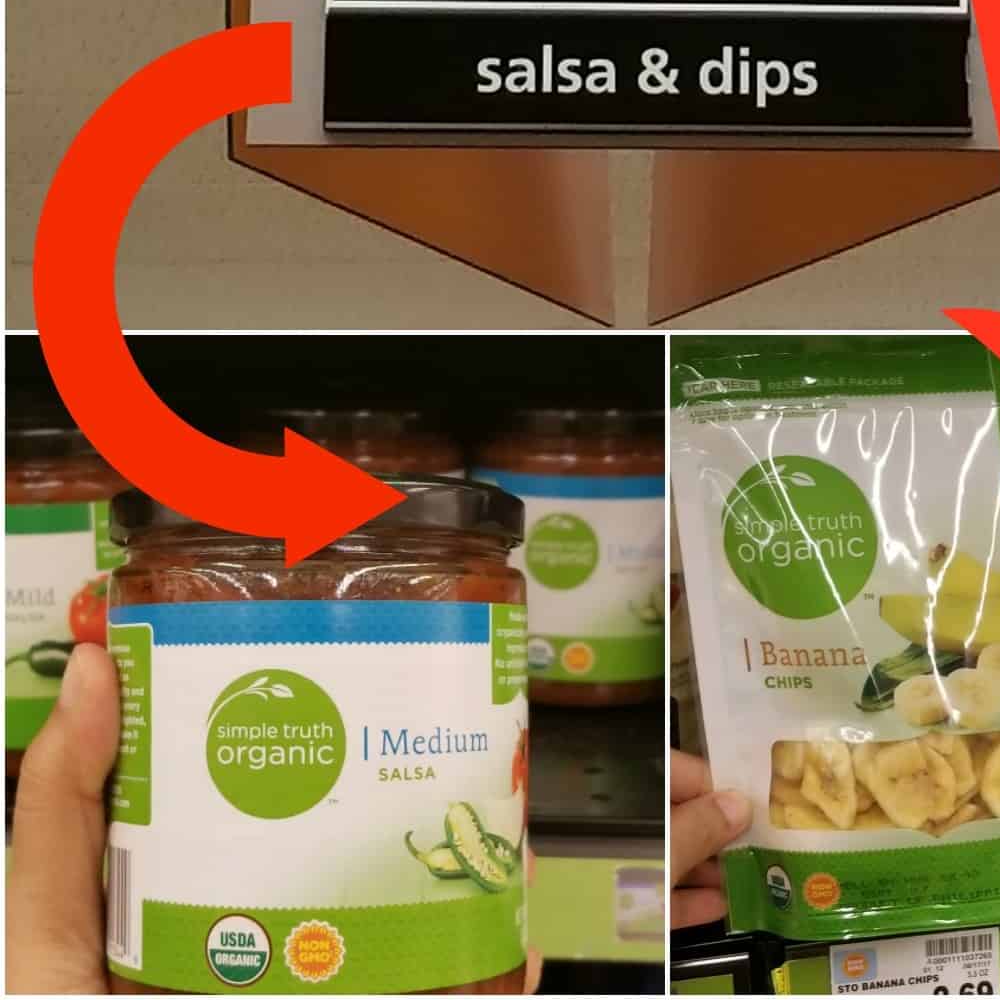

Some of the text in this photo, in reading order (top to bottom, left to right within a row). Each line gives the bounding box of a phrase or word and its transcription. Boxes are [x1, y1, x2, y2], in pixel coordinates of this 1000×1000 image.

[477, 45, 819, 108] salsa & dips
[735, 513, 863, 536] simple truth
[737, 532, 865, 567] organic
[760, 640, 867, 667] Banana
[765, 676, 813, 689] CHIPS
[217, 722, 333, 740] simple truth
[380, 726, 488, 756] Medium
[217, 740, 335, 770] organic
[378, 766, 437, 782] SALSA
[220, 931, 256, 949] USDA
[299, 941, 330, 950] NON
[215, 952, 261, 967] ORGANIC
[299, 951, 330, 962] GMO
[838, 974, 940, 994] STO BANANA CHIPS
